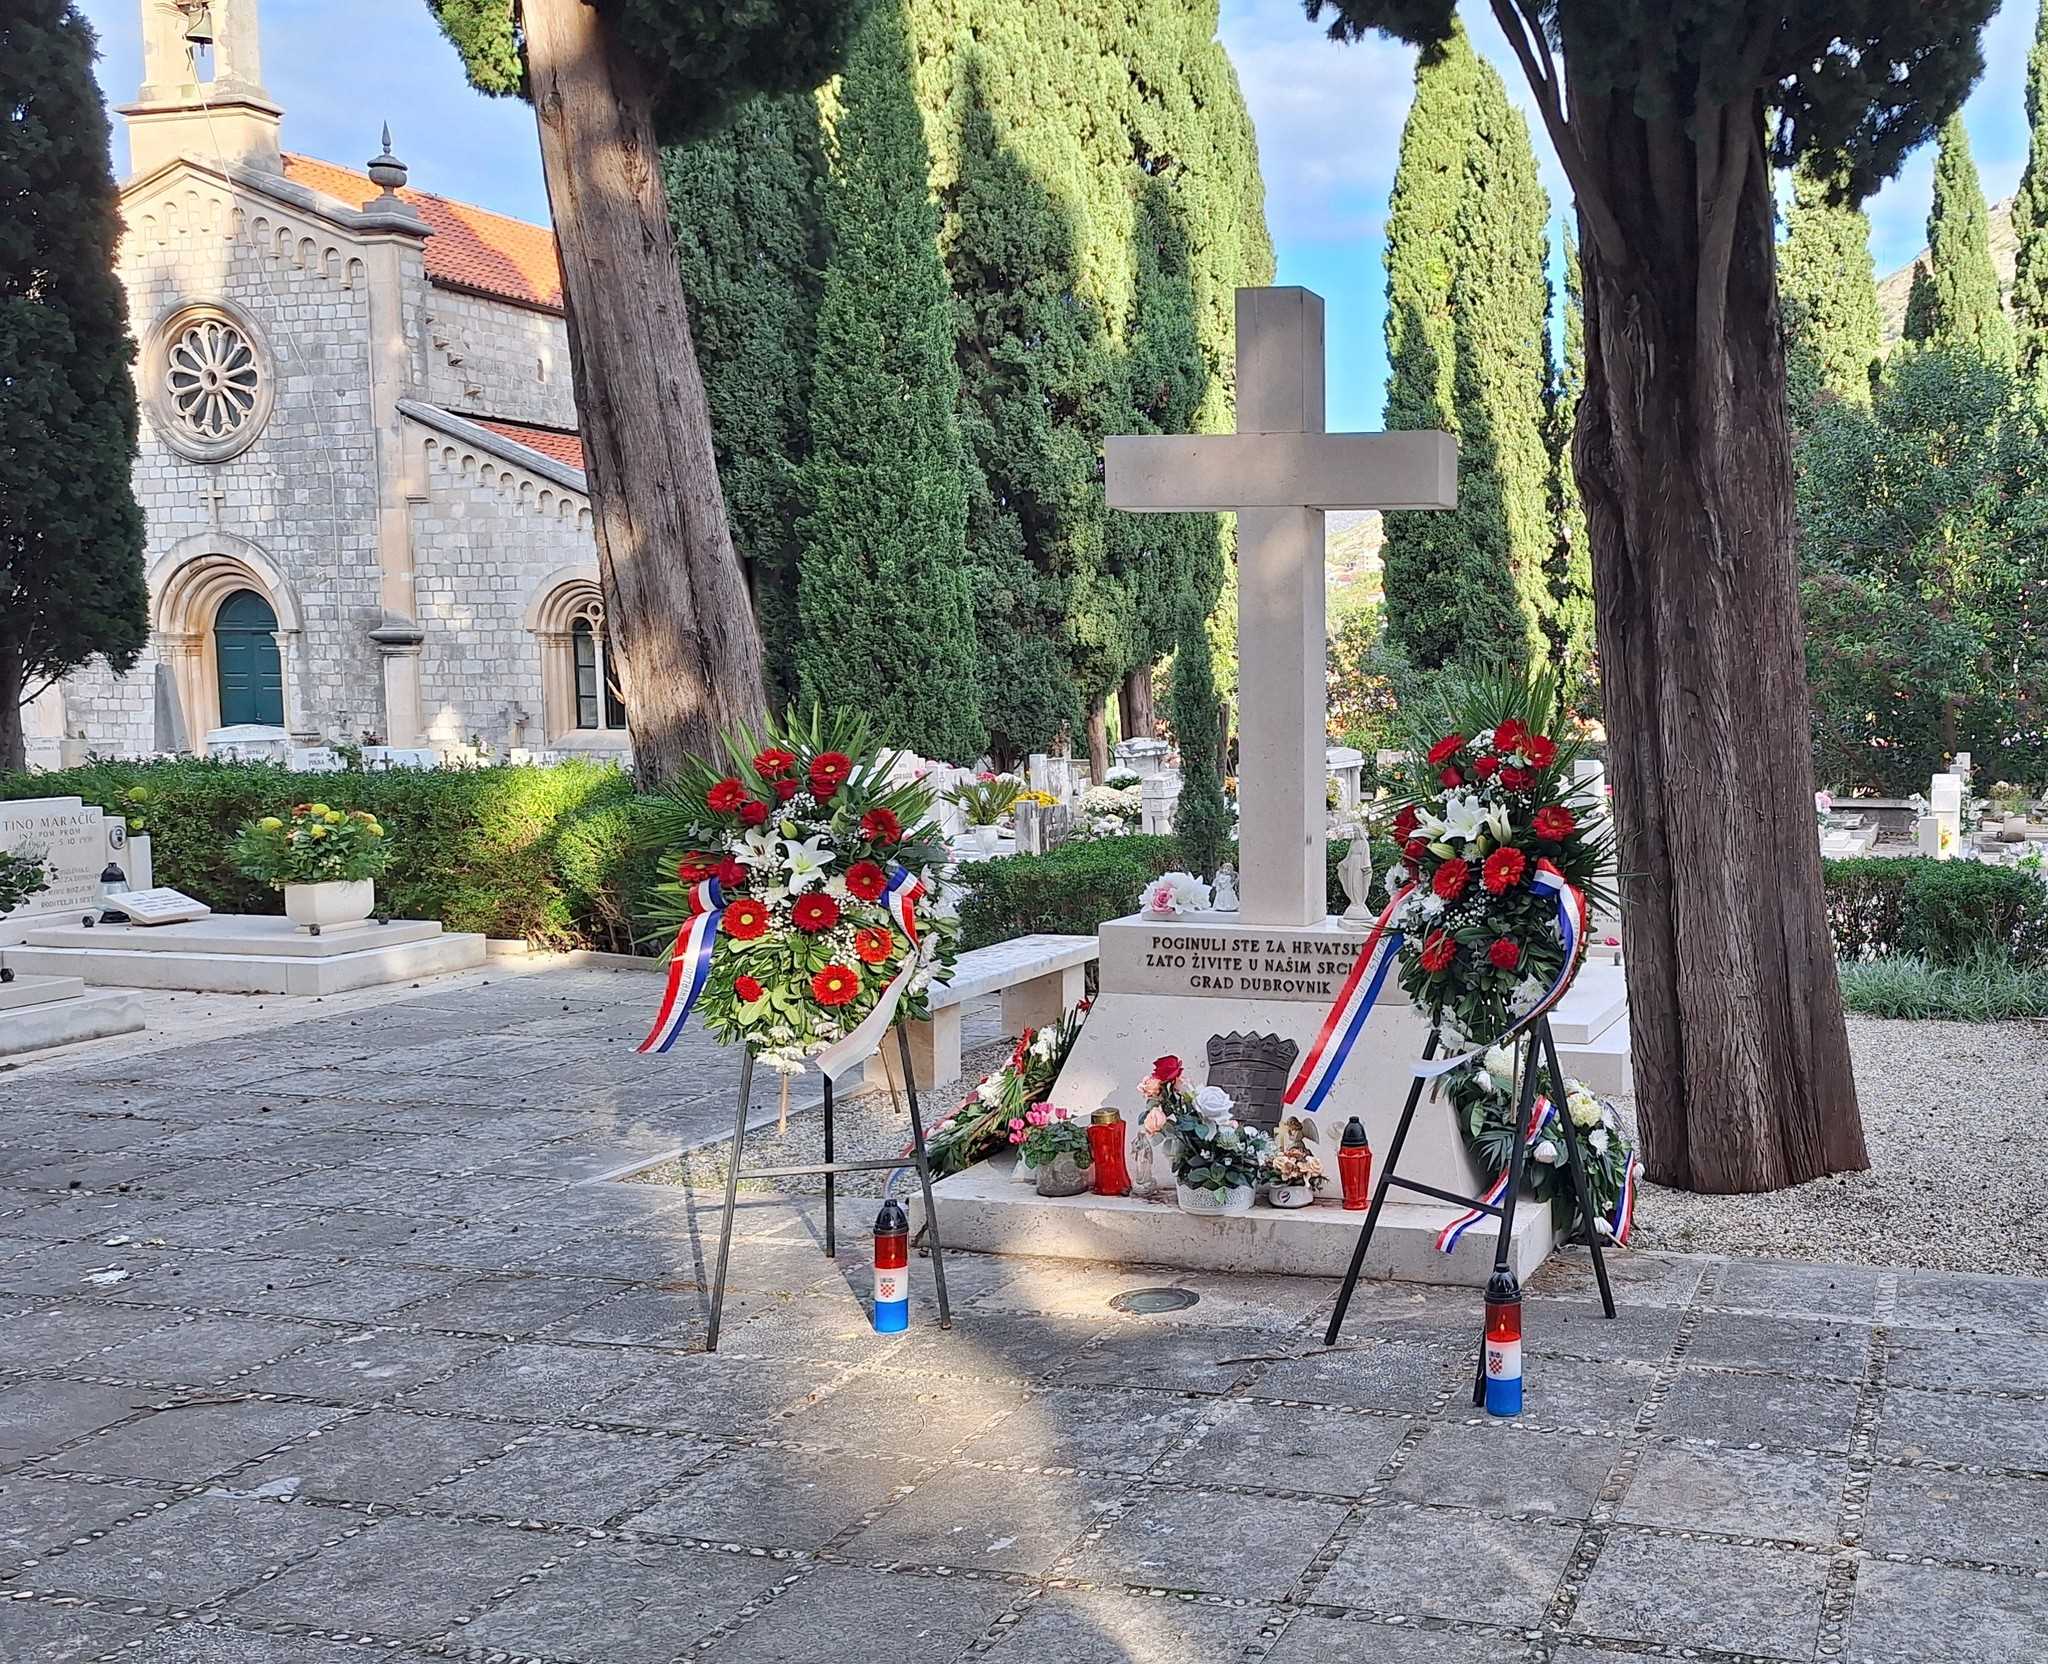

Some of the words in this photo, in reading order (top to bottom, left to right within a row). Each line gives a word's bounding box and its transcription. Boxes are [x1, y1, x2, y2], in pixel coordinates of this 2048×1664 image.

[3, 818, 34, 832] TINO
[1152, 936, 1226, 952] POGINULI
[1232, 939, 1260, 953] STE
[1266, 940, 1286, 954] ZA
[1292, 942, 1363, 956] HRVATSK
[1146, 954, 1186, 968] ZATO
[1191, 955, 1243, 971] ŽIVITE
[1249, 958, 1258, 971] U
[1264, 957, 1311, 974] NAŠIM
[1317, 961, 1354, 976] SRCI
[1190, 976, 1234, 990] GRAD
[1240, 977, 1332, 995] DUBROVNIK
